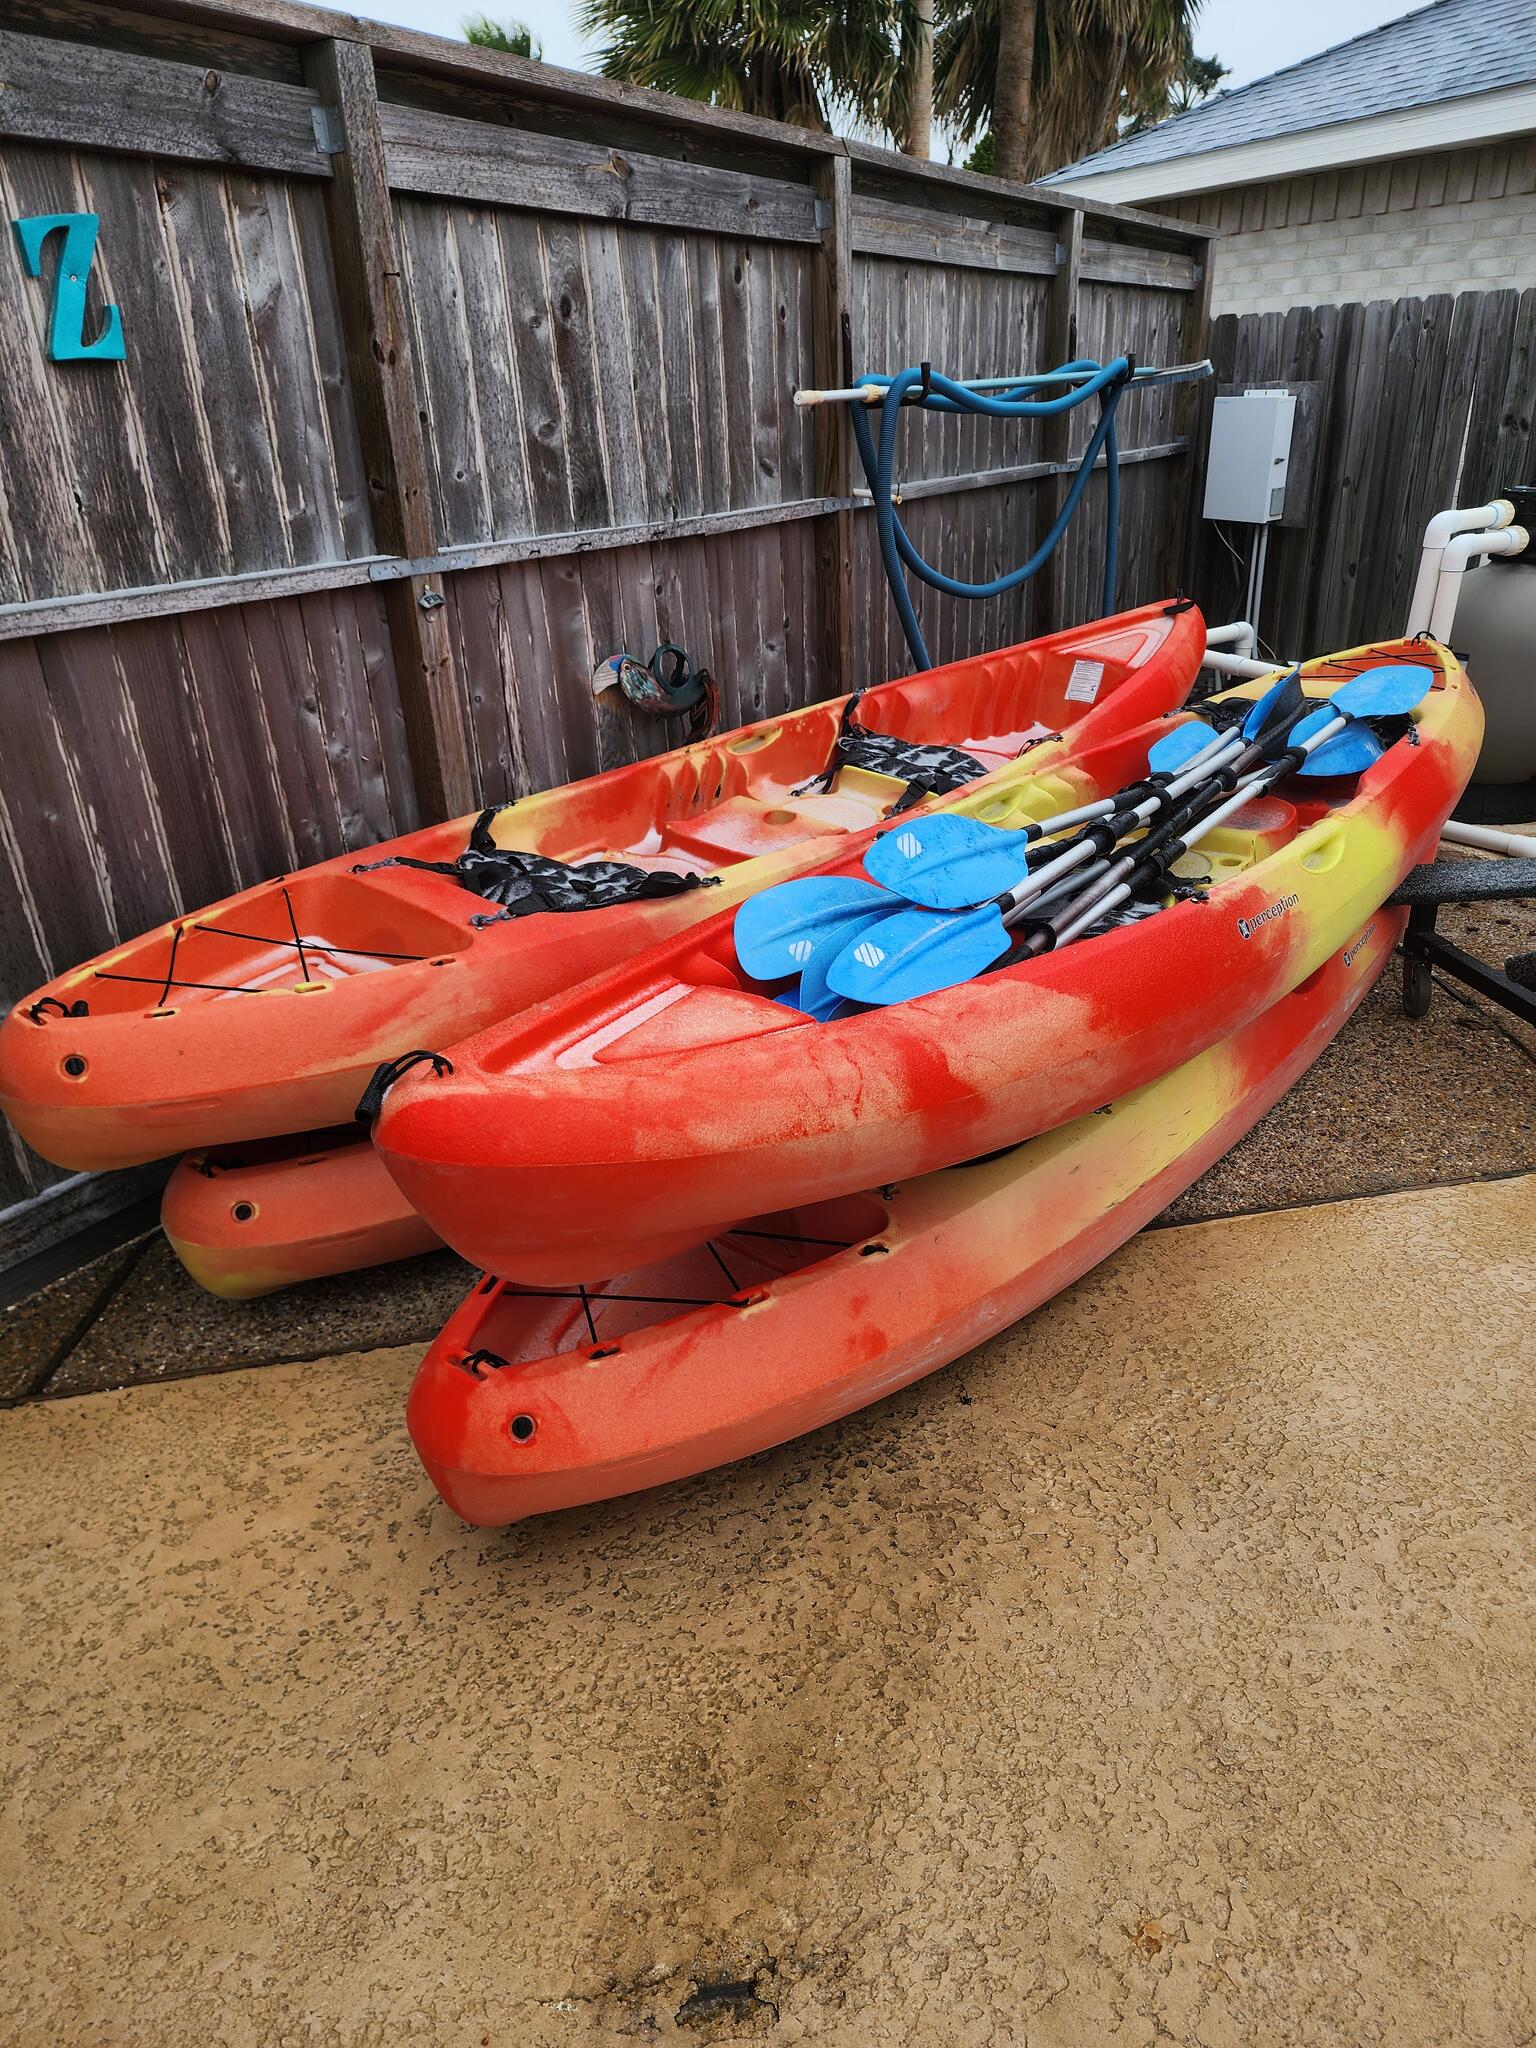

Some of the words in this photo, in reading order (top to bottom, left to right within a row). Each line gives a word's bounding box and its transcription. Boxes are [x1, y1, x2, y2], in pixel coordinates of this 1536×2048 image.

[11, 212, 127, 361] Z
[1249, 893, 1300, 933] perception
[1349, 922, 1377, 961] perception
